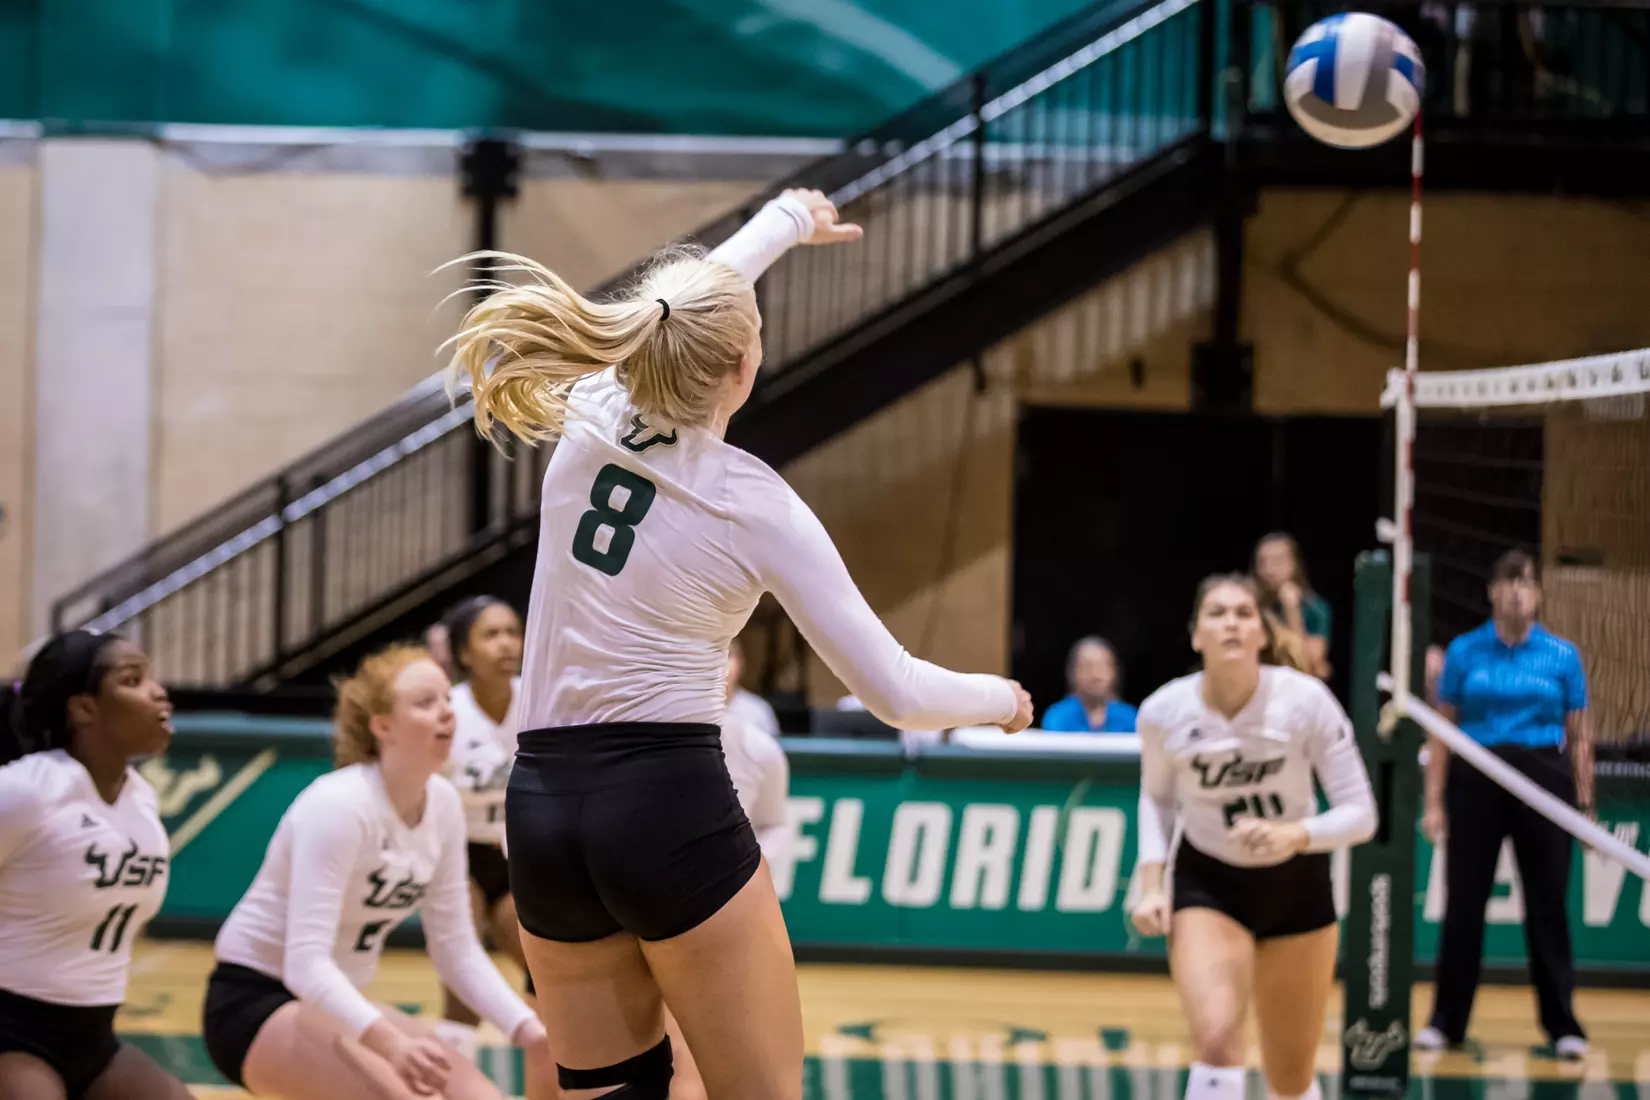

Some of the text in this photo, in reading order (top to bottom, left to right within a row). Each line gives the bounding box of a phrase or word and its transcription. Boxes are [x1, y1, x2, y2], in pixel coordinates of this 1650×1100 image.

[572, 463, 656, 576] 8
[85, 838, 167, 888] USF
[91, 902, 138, 953] 11
